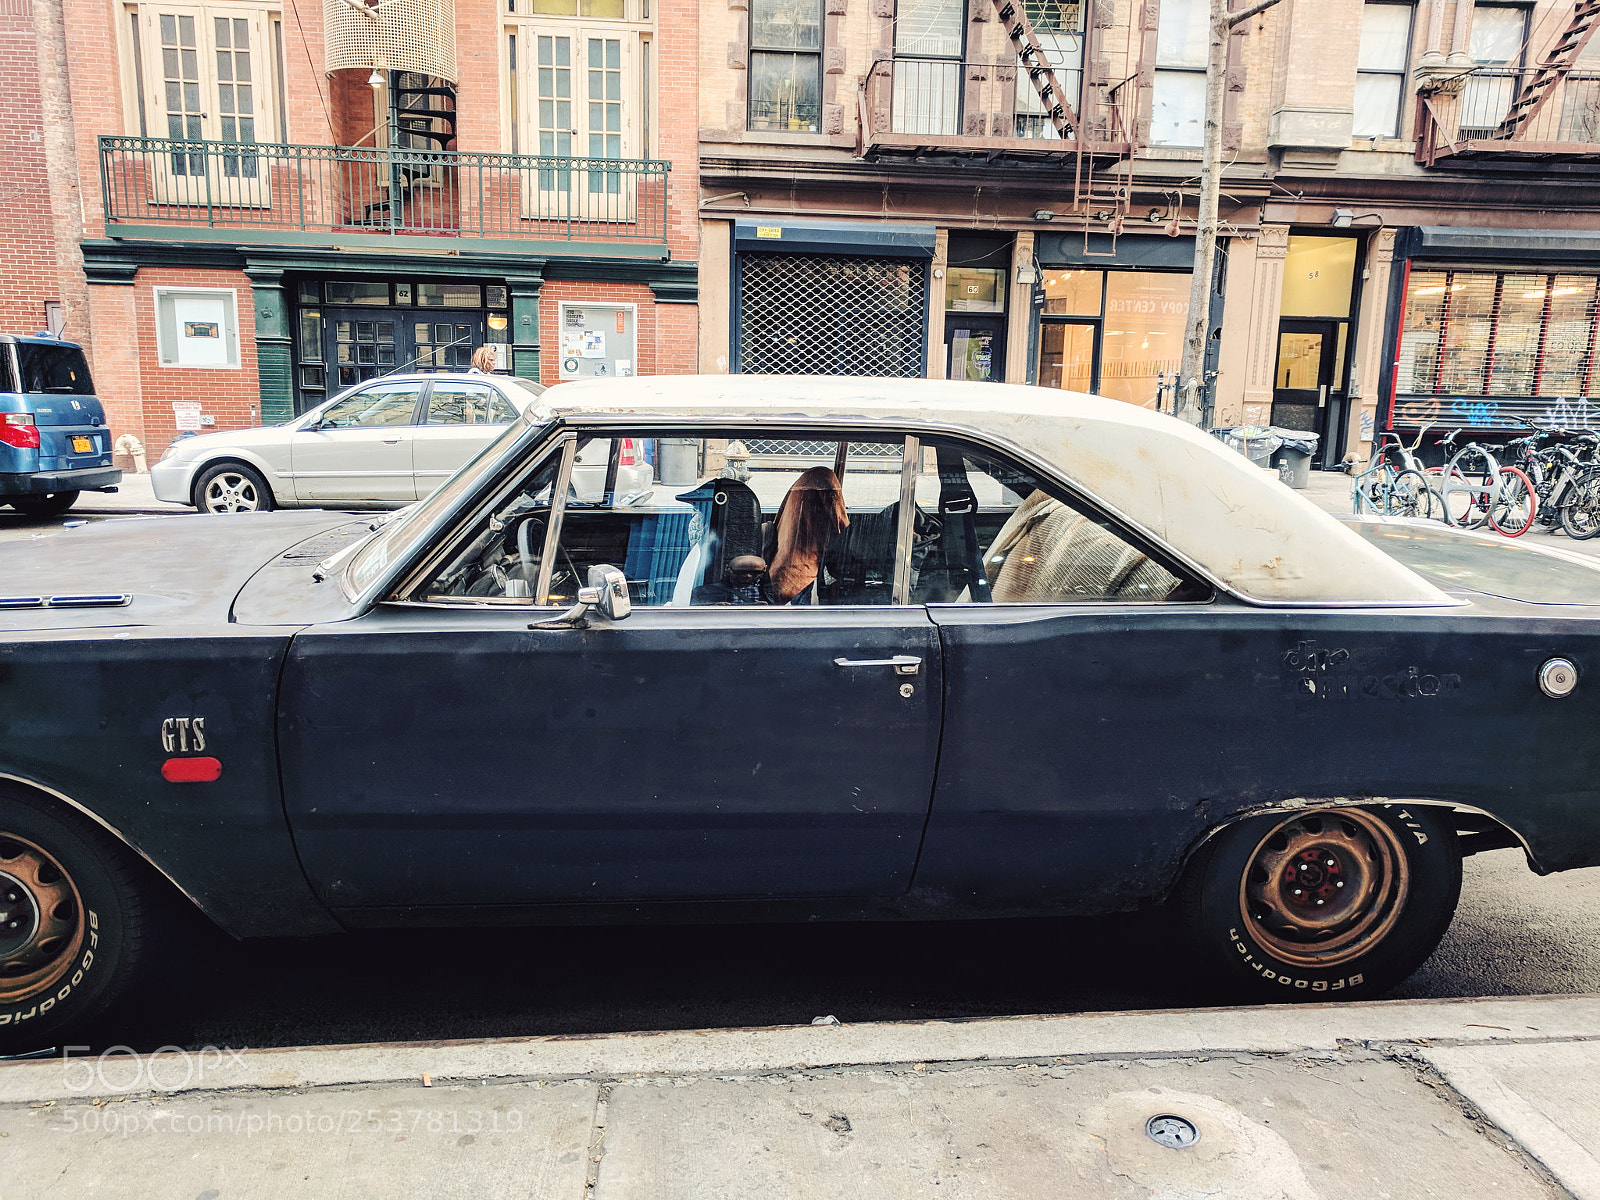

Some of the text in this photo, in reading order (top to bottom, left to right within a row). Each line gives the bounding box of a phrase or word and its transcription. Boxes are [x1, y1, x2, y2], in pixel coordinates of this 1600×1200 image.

[1308, 270, 1319, 279] 58
[398, 290, 409, 298] 62
[162, 717, 206, 752] GTS
[1229, 928, 1364, 992] BFGoodrich
